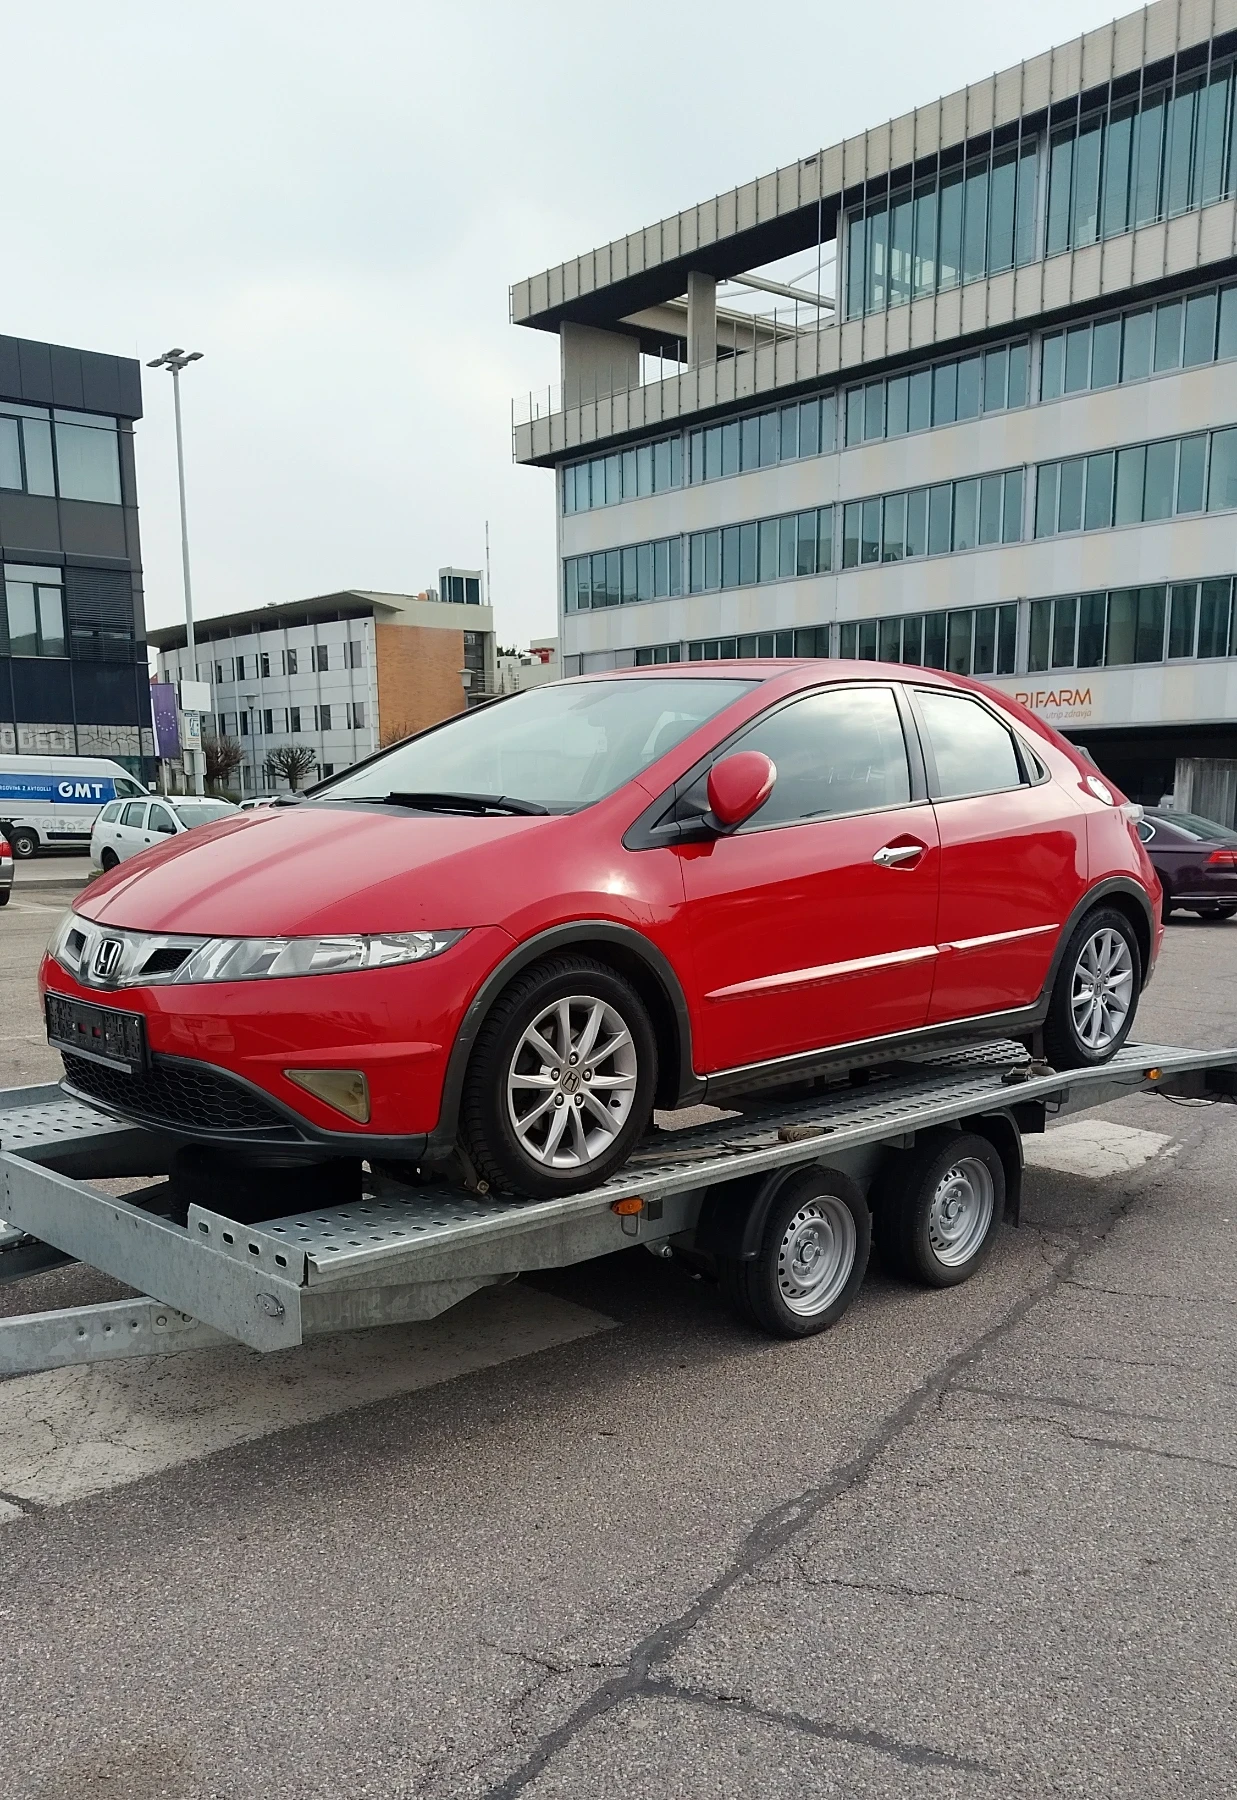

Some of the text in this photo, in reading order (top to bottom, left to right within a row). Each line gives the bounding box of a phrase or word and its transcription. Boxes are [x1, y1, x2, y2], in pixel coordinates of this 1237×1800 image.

[1015, 688, 1092, 708] RIFARM
[1046, 709, 1092, 720] utrip zdravja
[58, 782, 103, 798] GMT
